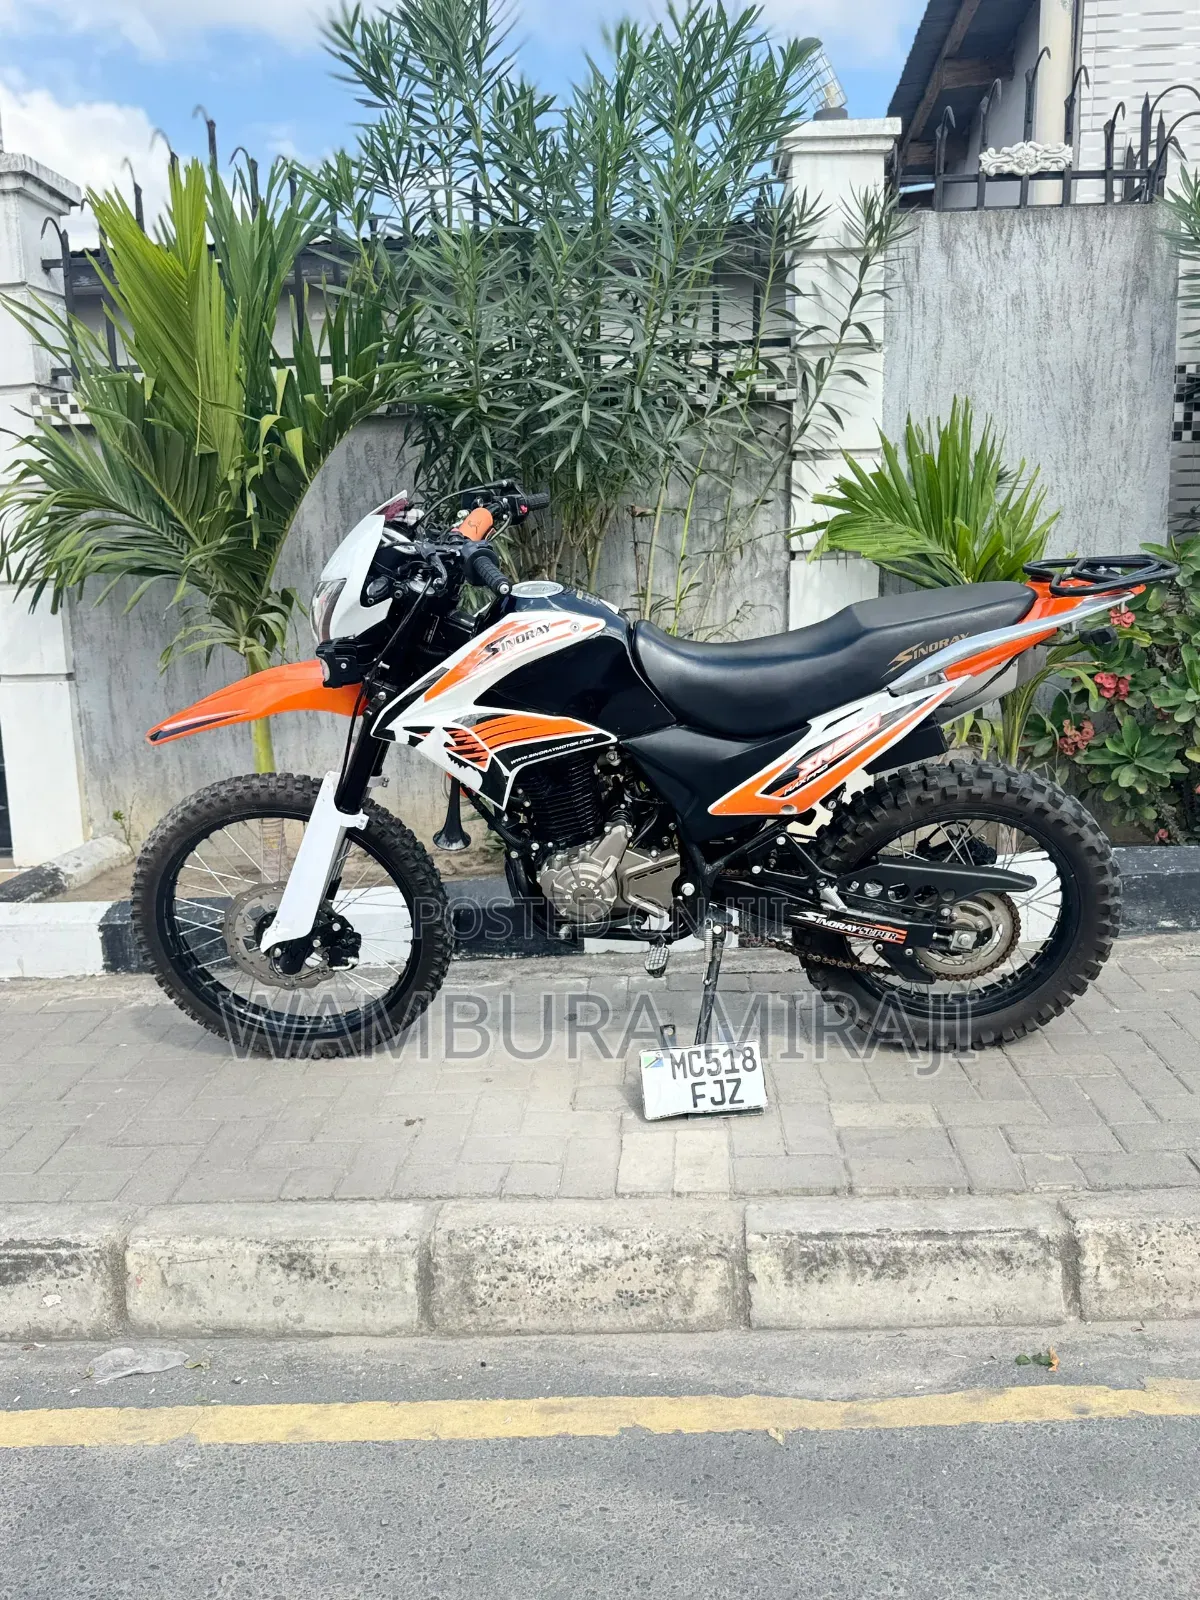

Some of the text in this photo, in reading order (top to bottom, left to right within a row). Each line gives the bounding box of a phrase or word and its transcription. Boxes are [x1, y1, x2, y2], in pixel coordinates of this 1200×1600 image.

[476, 623, 551, 667] SINORAY
[880, 632, 970, 679] SINORAY
[564, 880, 602, 900] SINORAY
[670, 1046, 757, 1080] MC518
[690, 1078, 745, 1108] FJZ
